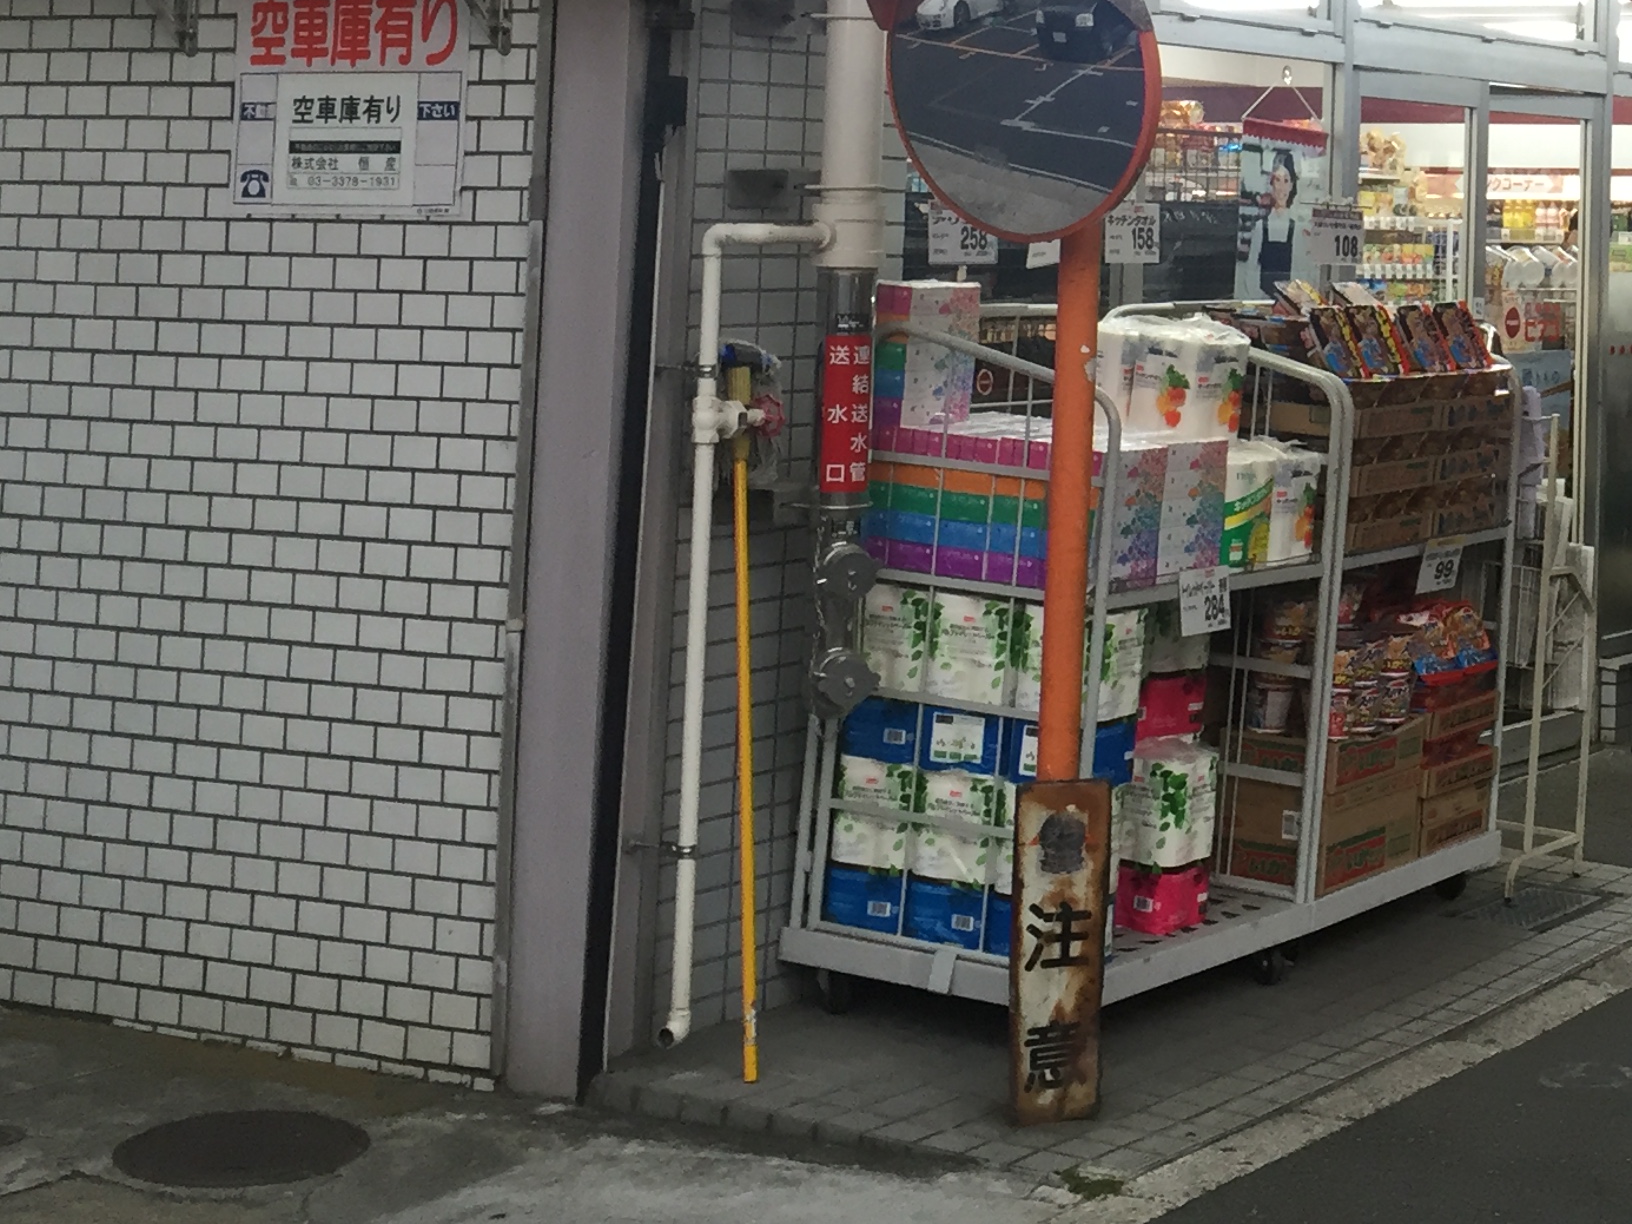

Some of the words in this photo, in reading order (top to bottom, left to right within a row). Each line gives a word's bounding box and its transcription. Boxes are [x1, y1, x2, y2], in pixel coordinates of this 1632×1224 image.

[292, 94, 401, 124] 空車庫有り
[418, 104, 456, 119] 下さい
[291, 156, 339, 171] 株式会社
[960, 226, 988, 251] 258
[1131, 227, 1154, 250] 158
[1334, 234, 1358, 258] 108
[826, 345, 850, 483] 送水口
[850, 345, 871, 483] 連結送水管
[1434, 559, 1455, 580] 99
[1024, 901, 1092, 1093] 注意
